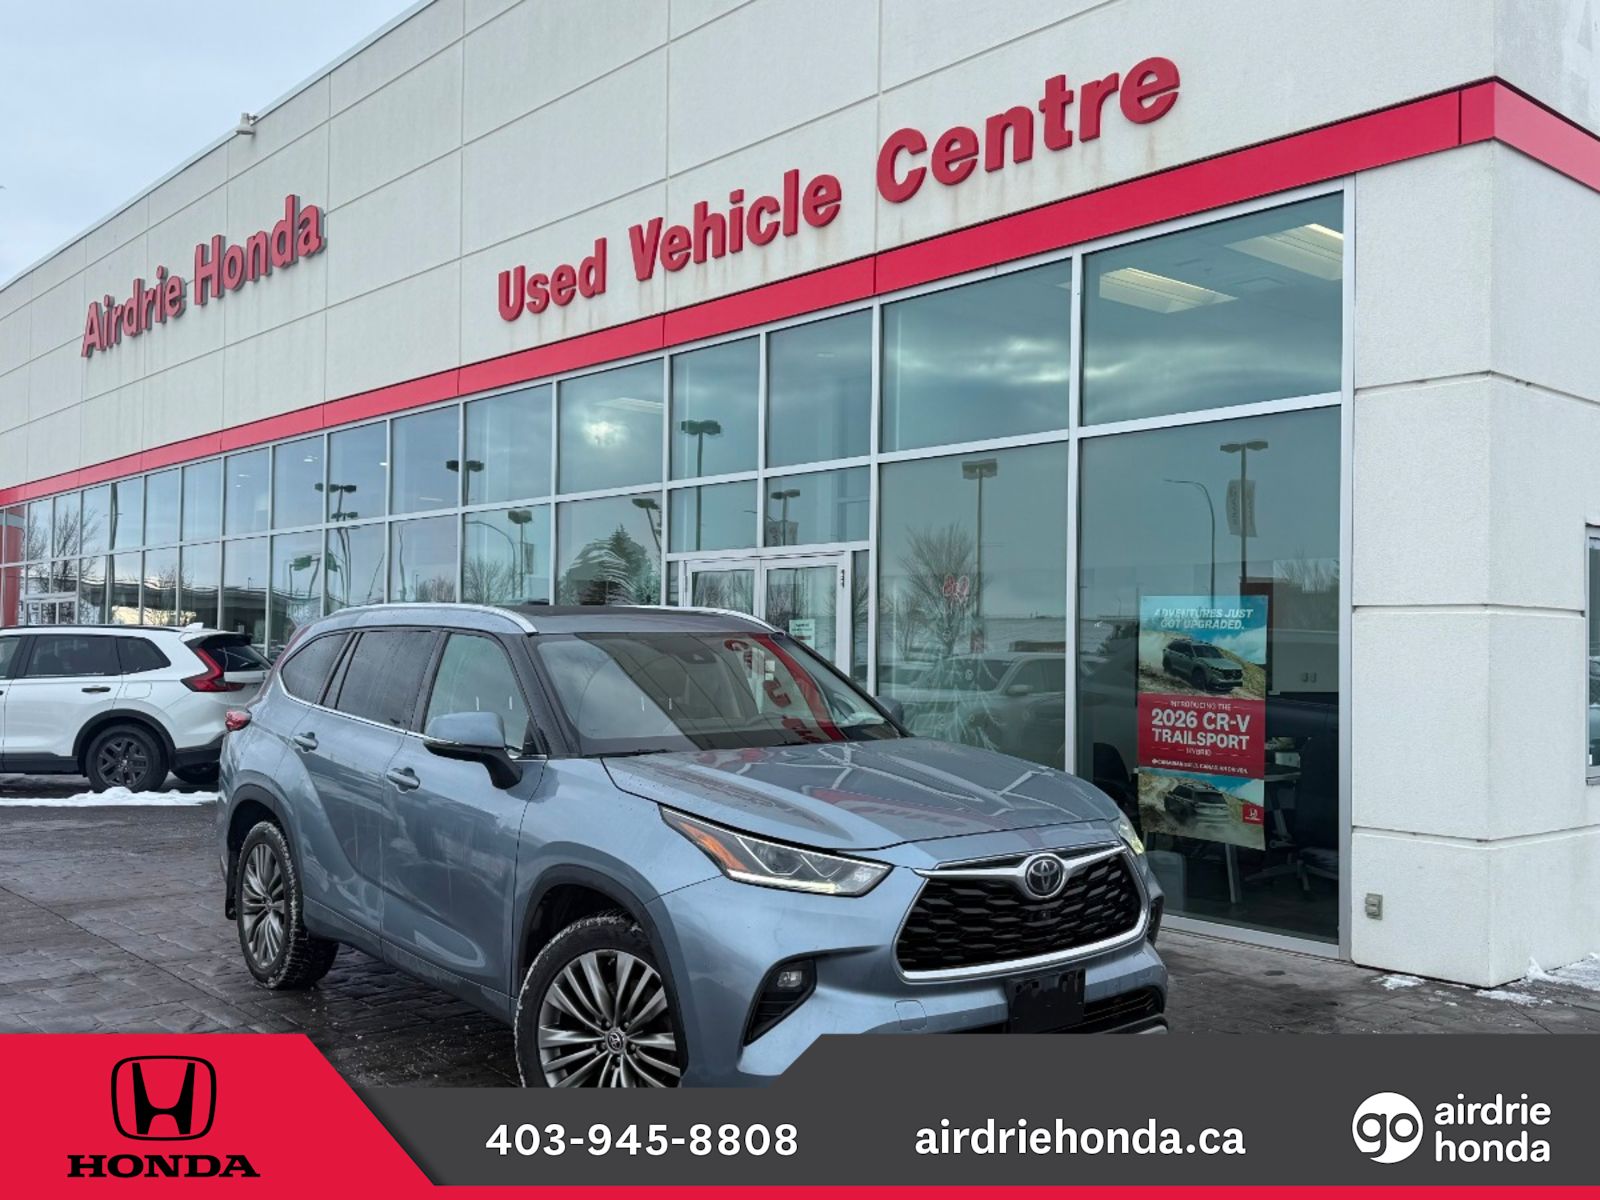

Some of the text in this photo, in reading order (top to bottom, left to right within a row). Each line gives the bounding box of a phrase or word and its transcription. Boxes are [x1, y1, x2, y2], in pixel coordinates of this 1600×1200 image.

[498, 56, 1181, 322] Used Vehicle Centre
[81, 194, 327, 358] Airdrie Honda
[1155, 608, 1254, 619] ADVENTURES JUST
[1160, 619, 1245, 630] GOT UPGRADED.
[1218, 703, 1232, 711] THE
[1151, 708, 1251, 733] 2026 CR-V
[1151, 727, 1250, 750] TRAILSPORT
